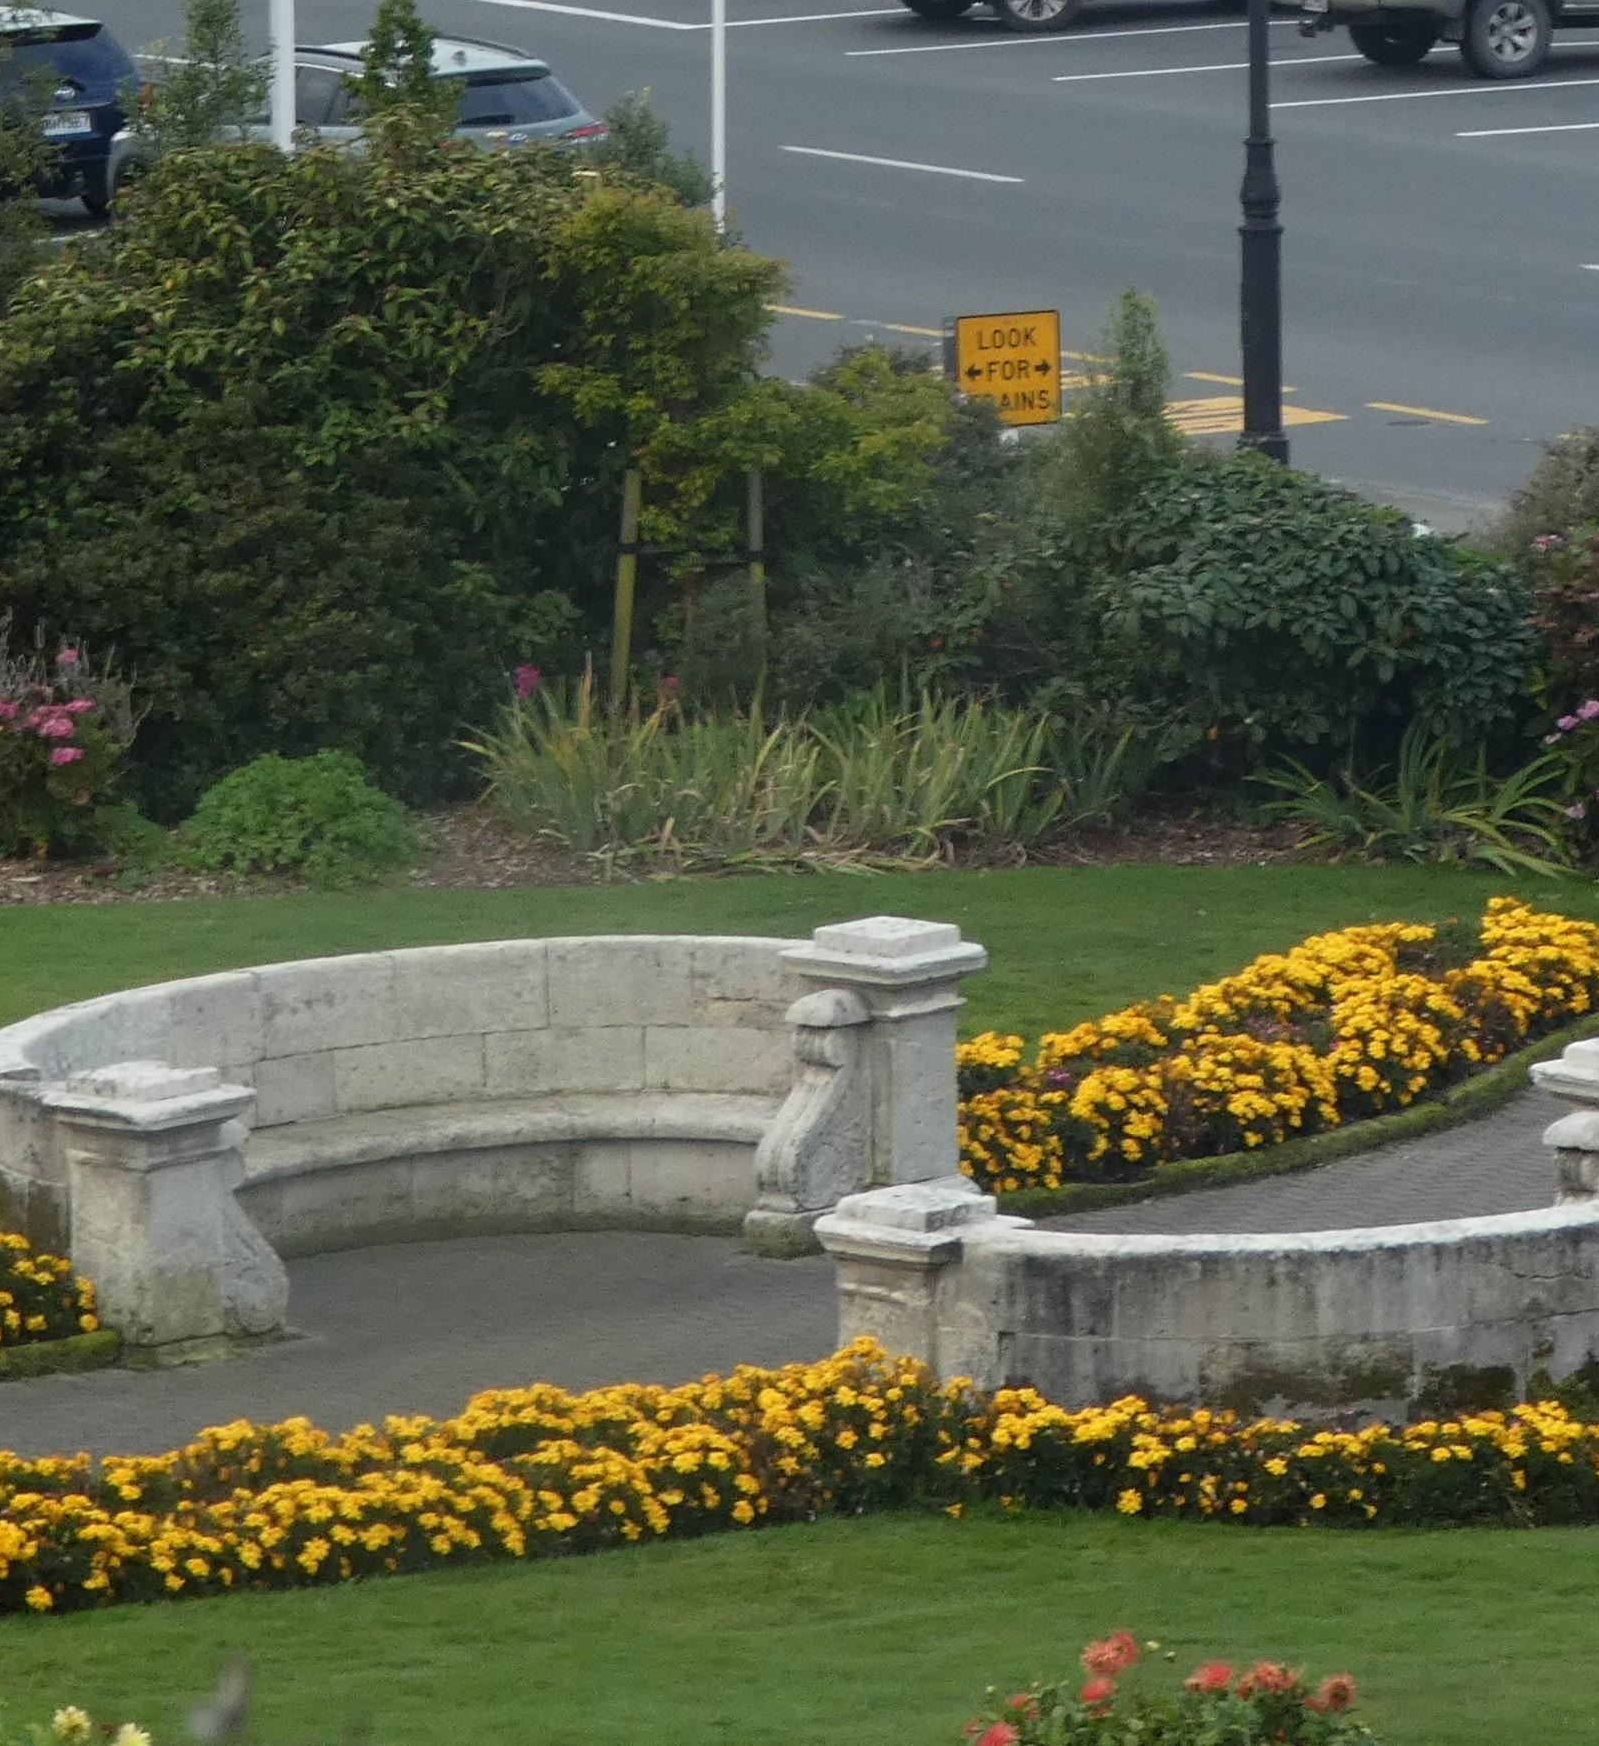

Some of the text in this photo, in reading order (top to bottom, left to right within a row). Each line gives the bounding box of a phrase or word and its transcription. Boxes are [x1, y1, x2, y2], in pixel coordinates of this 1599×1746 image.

[976, 326, 1037, 351] LOOK
[986, 358, 1031, 382] FOR
[1001, 389, 1051, 411] AINS
